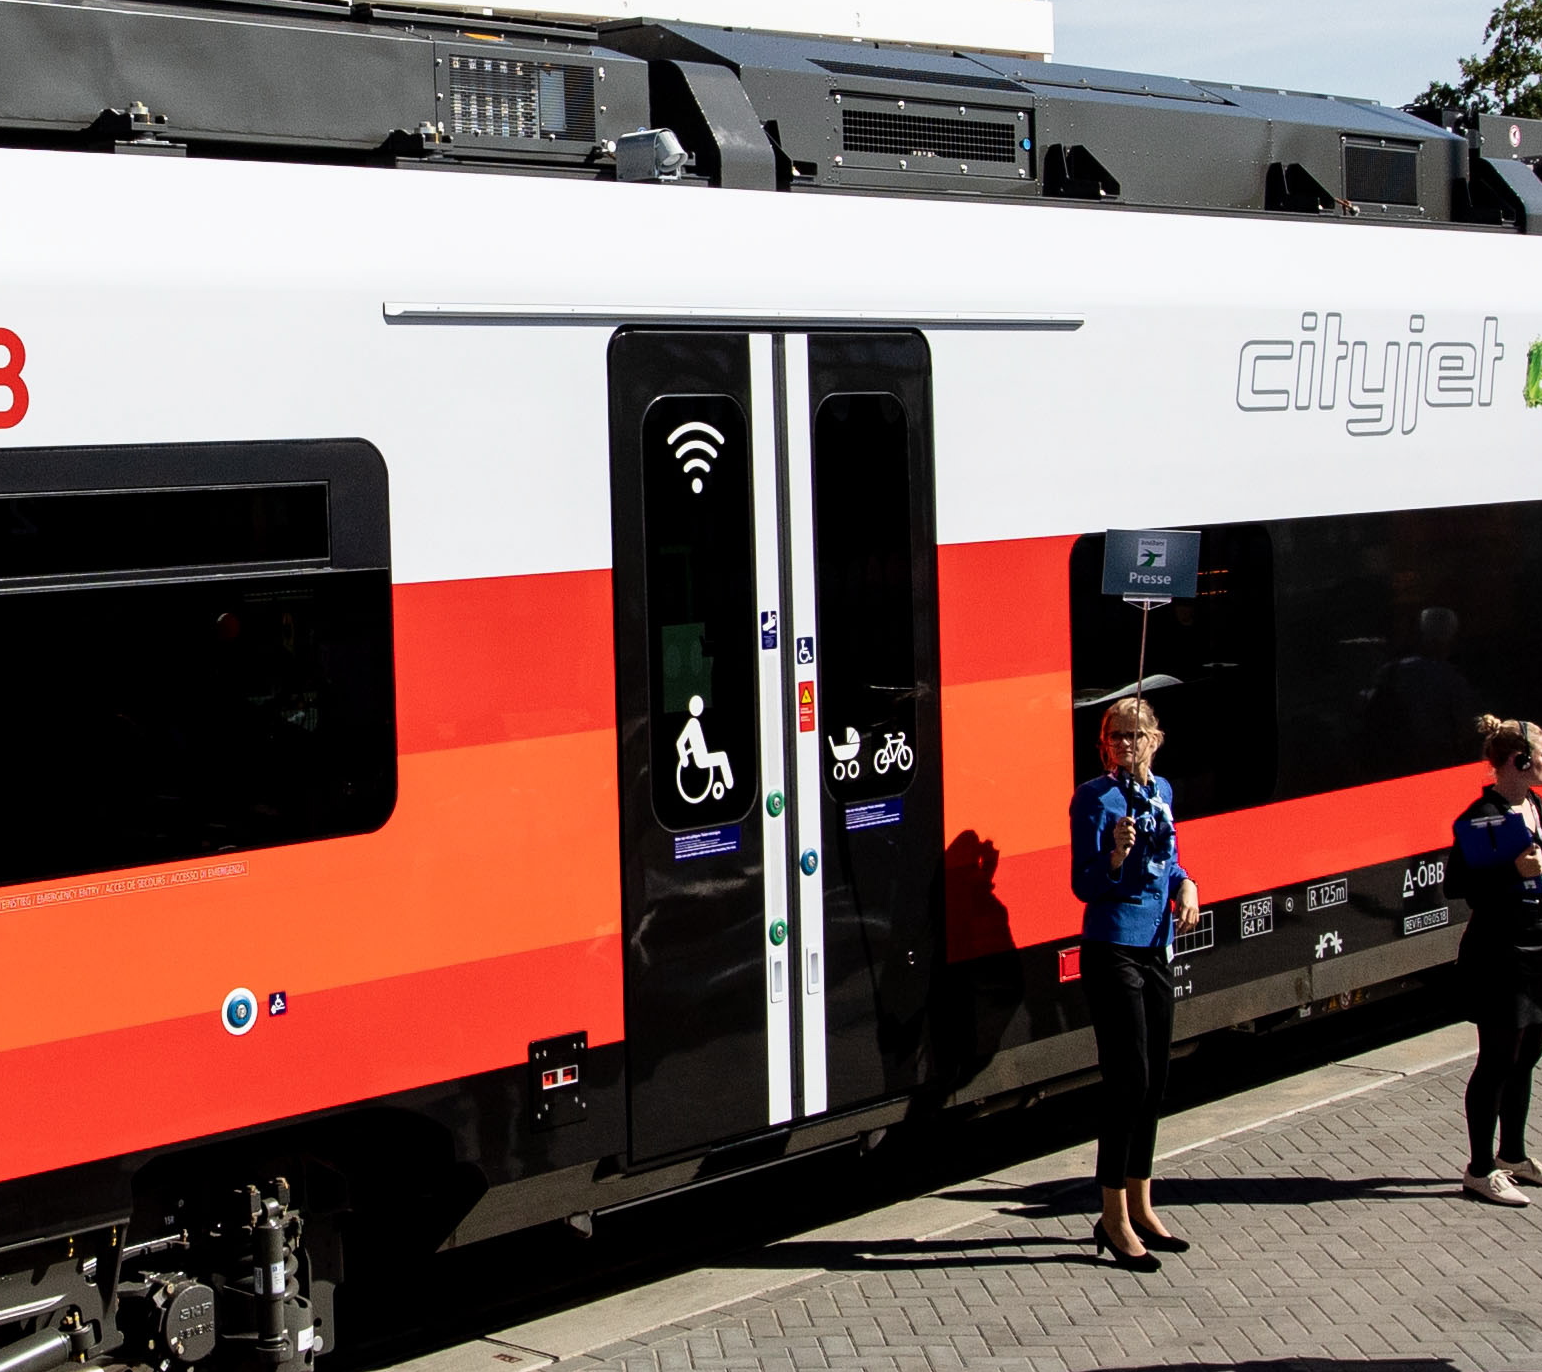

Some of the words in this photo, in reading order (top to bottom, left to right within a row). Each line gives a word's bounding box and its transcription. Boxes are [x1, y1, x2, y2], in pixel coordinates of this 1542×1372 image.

[1236, 311, 1504, 436] cityjet
[1129, 572, 1171, 585] Presse
[37, 889, 77, 904] EMERGENCY
[79, 886, 100, 898] ENTRY
[127, 880, 136, 890] DE
[137, 874, 166, 889] SECOURS
[170, 870, 199, 884] ACCESSO
[200, 869, 207, 879] DI
[208, 863, 246, 878] EMERGENZA
[1403, 860, 1445, 893] A-ÖBB
[1310, 891, 1317, 907] R
[1320, 885, 1345, 905] 125m
[1243, 921, 1255, 935] 64
